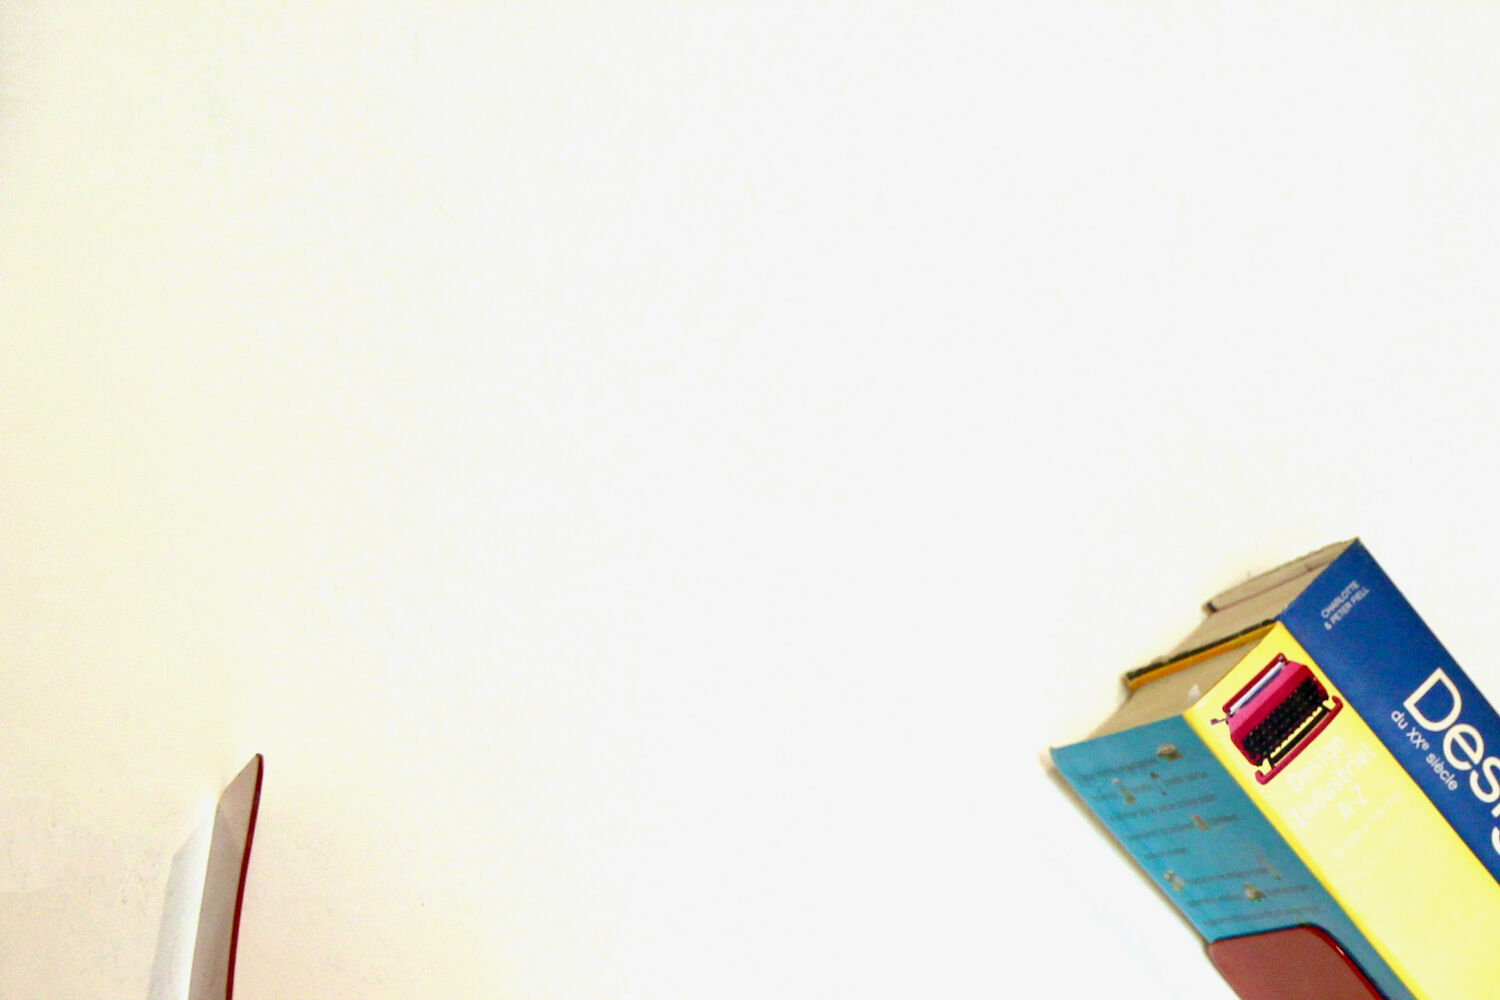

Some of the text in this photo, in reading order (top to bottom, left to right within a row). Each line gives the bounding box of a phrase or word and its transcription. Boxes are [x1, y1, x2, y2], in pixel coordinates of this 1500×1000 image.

[1289, 736, 1346, 792] Design
[1289, 741, 1376, 828] Industriel
[1390, 710, 1407, 729] du
[1426, 753, 1457, 790] siècle
